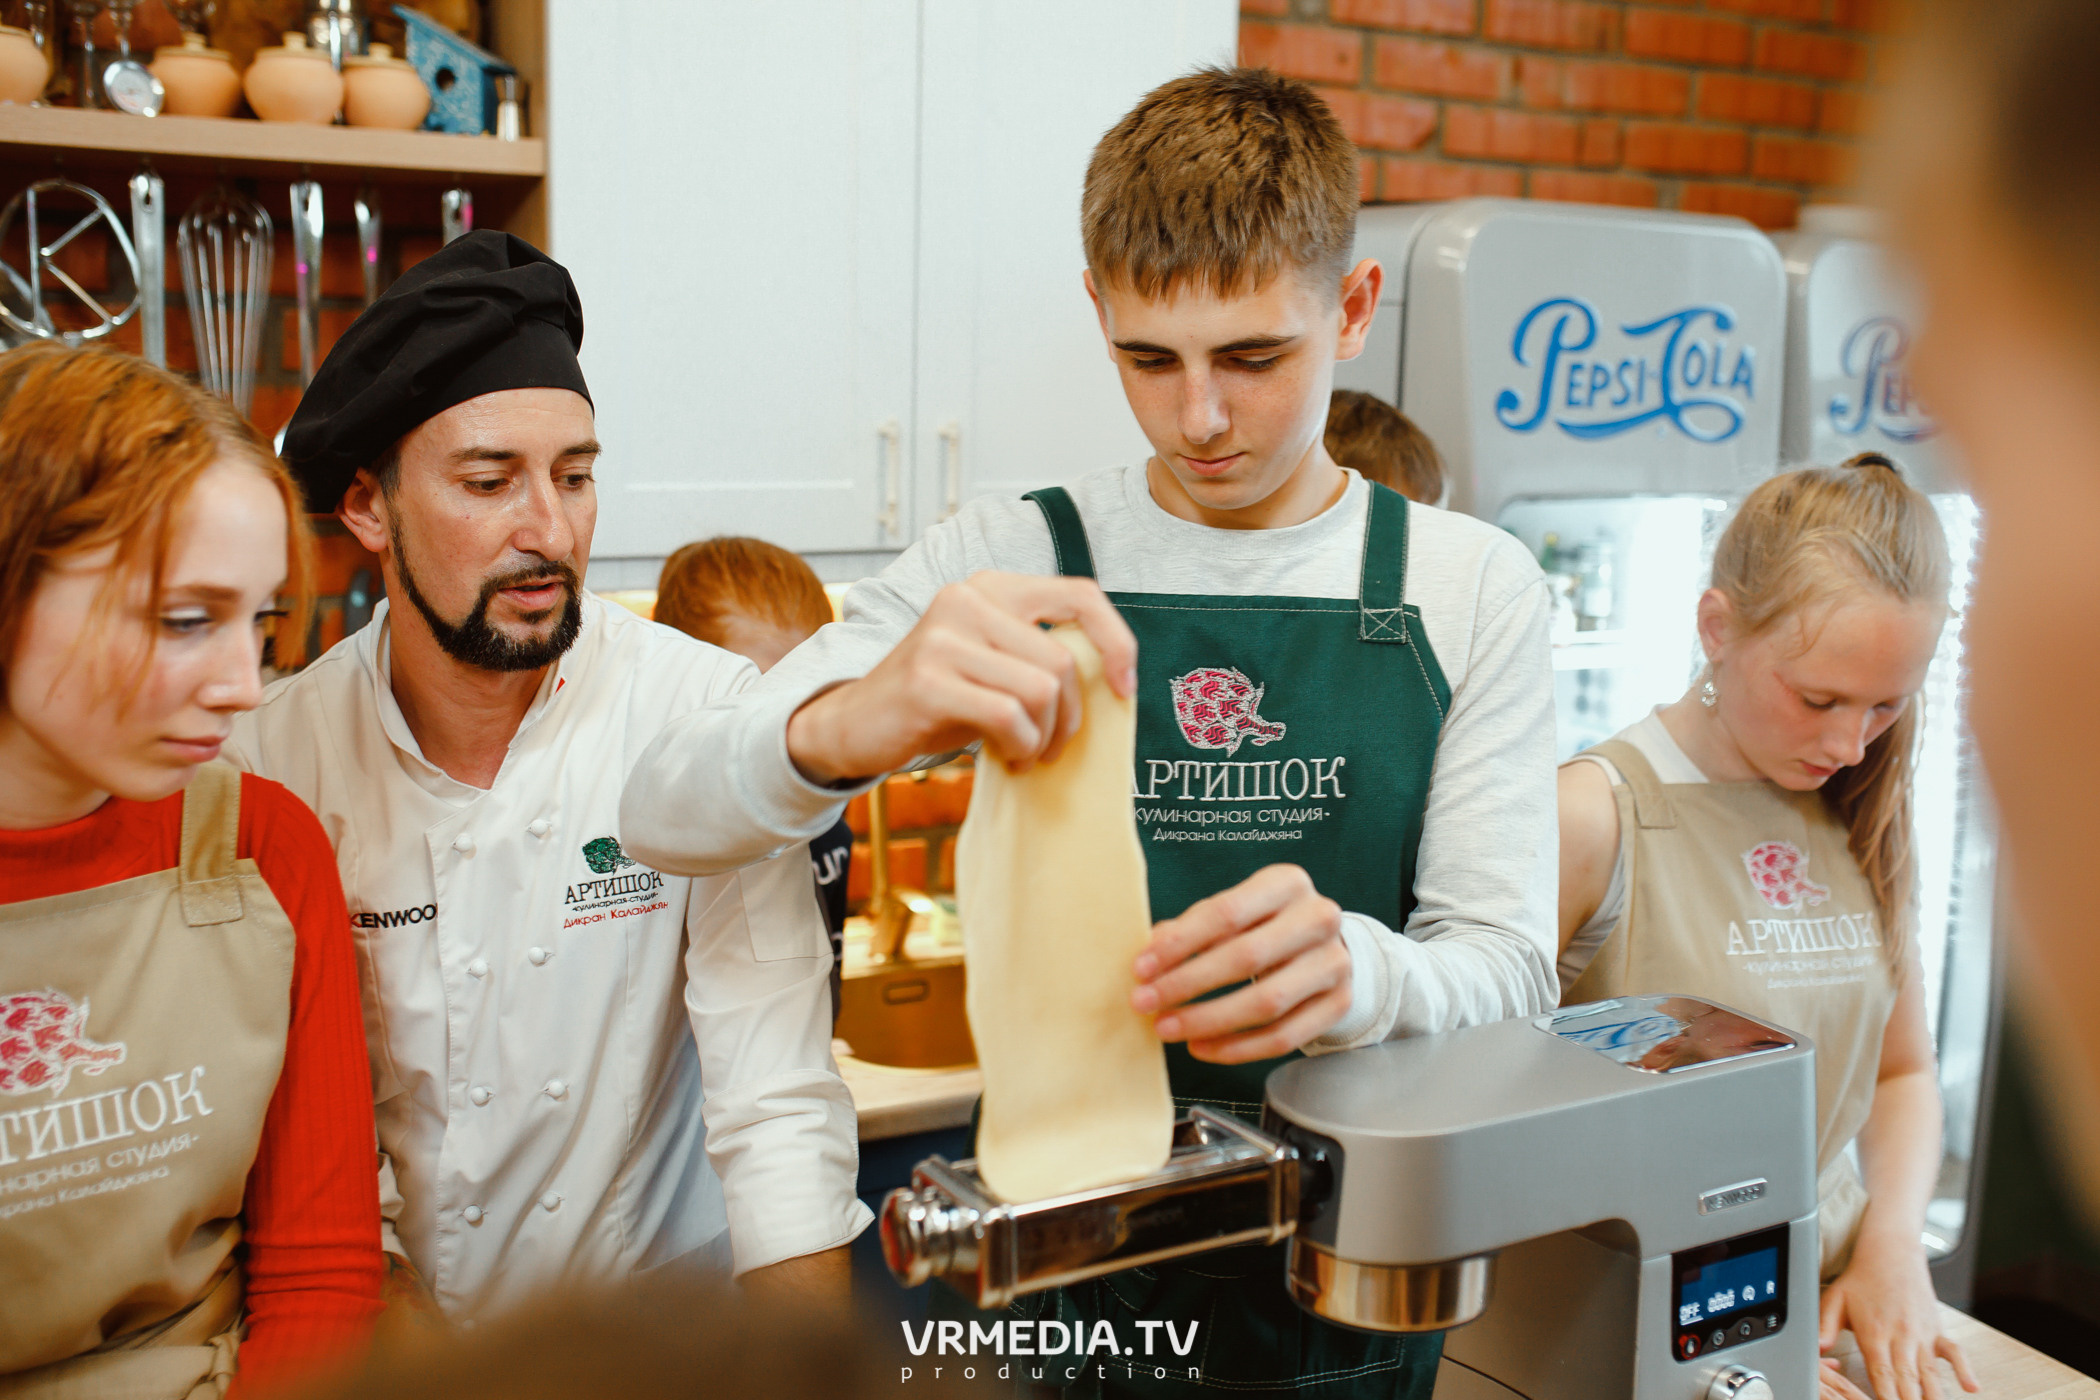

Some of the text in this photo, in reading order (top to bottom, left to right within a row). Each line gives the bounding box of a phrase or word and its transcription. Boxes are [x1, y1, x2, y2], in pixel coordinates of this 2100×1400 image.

[1152, 827, 1303, 842] Дикрана Калайджяна
[564, 871, 664, 904] АРТИШОК
[350, 902, 438, 928] KENWOO
[563, 901, 669, 929] Дикран Калайджян
[1725, 911, 1882, 955] АРТИШОК
